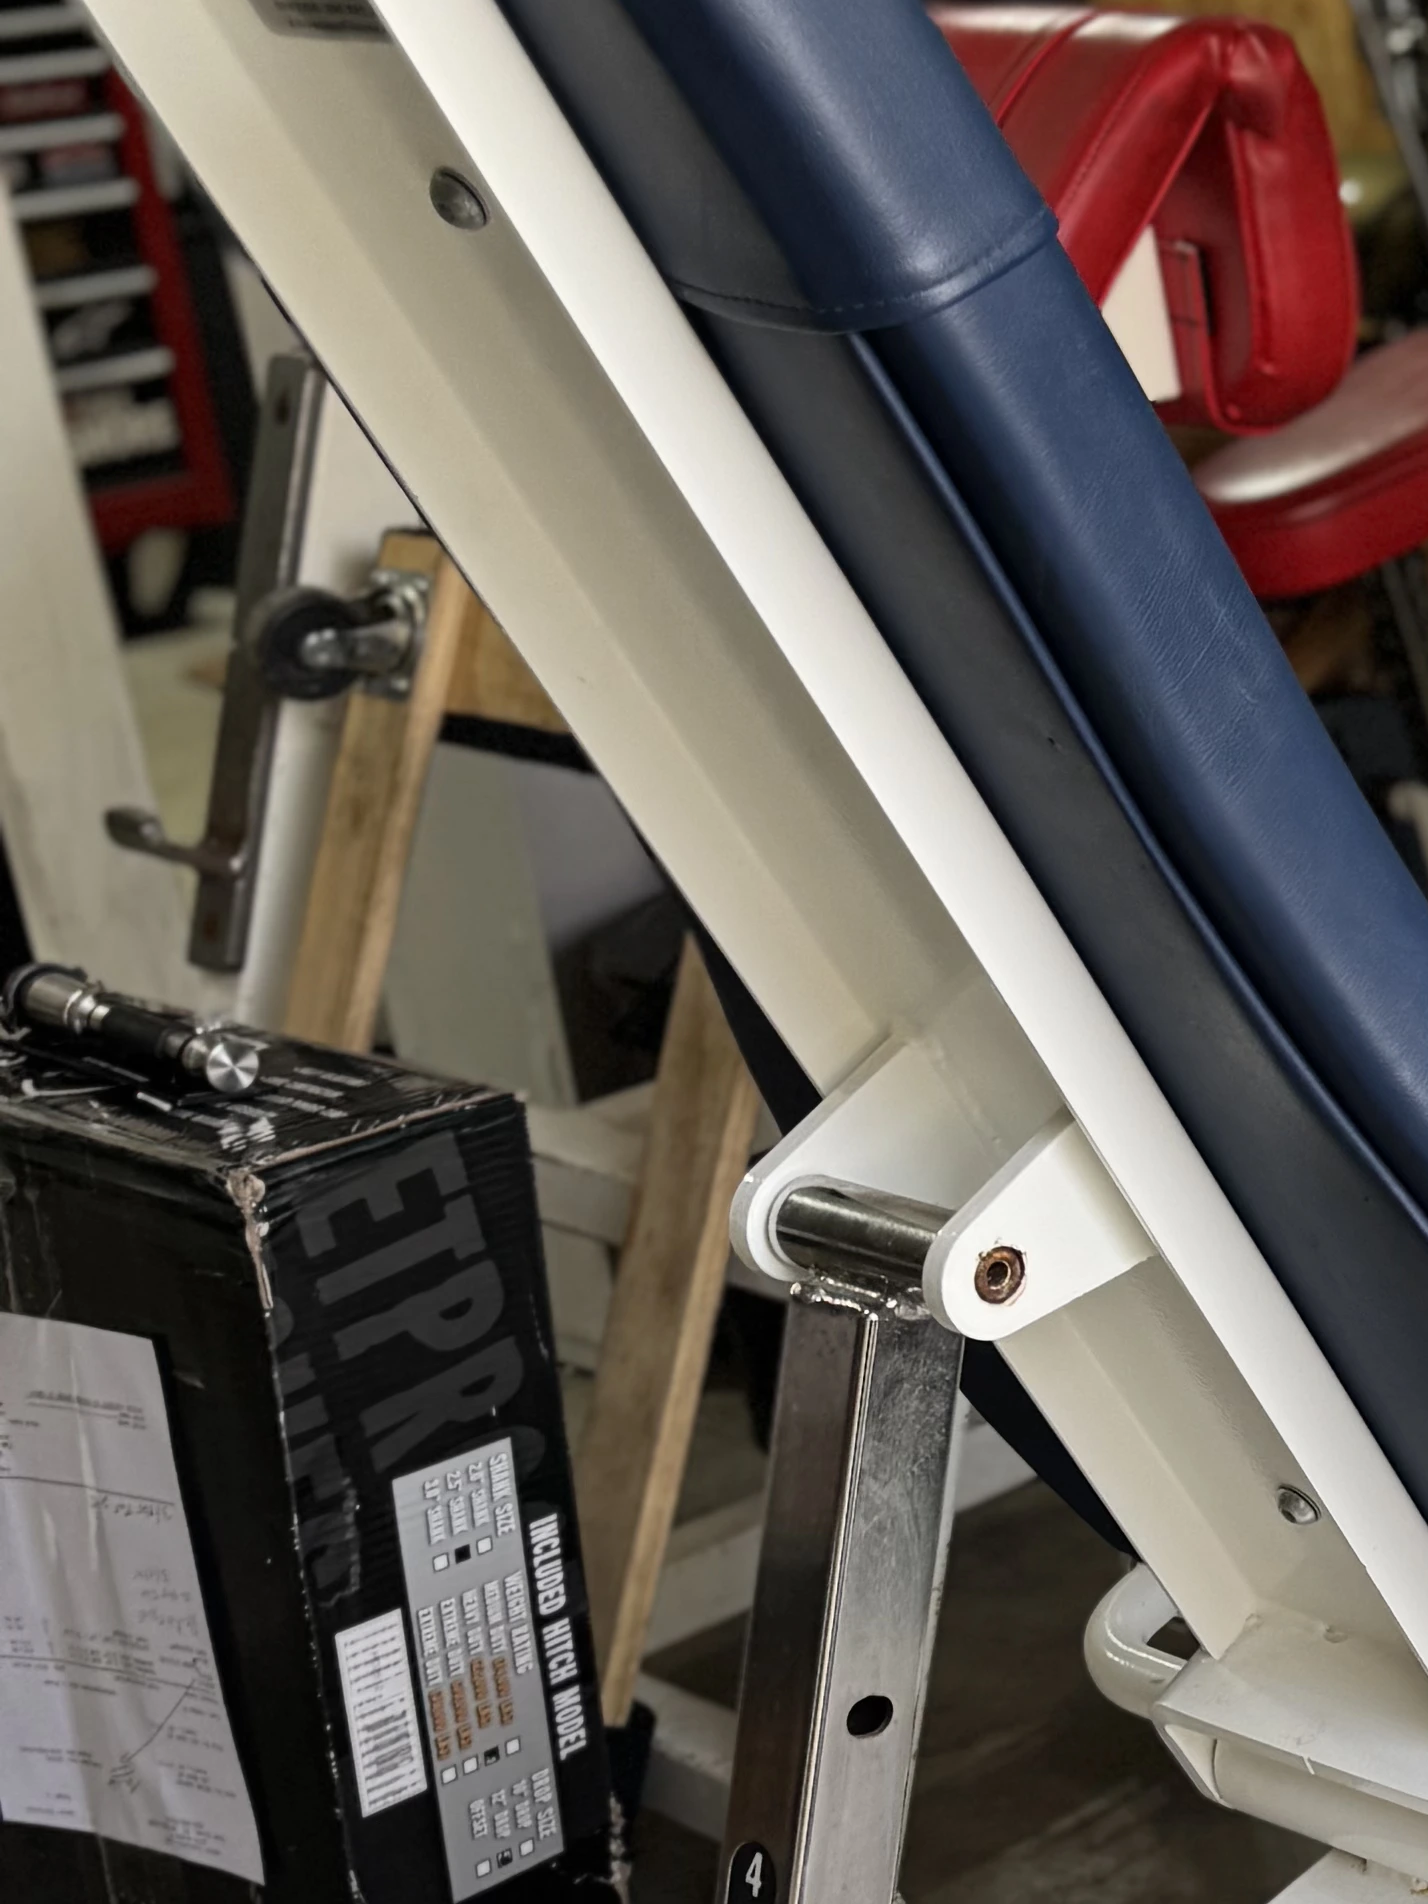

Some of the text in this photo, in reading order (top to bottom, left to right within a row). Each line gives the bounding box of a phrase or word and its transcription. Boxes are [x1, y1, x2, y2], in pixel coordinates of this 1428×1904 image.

[450, 1495, 469, 1536] SHANK
[489, 1452, 516, 1537] SHANK SIZE
[461, 1588, 481, 1625] HEAVY
[504, 1569, 534, 1675] WEIGHT RATING
[529, 1513, 588, 1761] INCLUDED HITCH MODEL
[468, 1797, 489, 1840] OFFSET
[530, 1768, 558, 1842] DROP SIZE
[744, 1851, 764, 1898] 4
